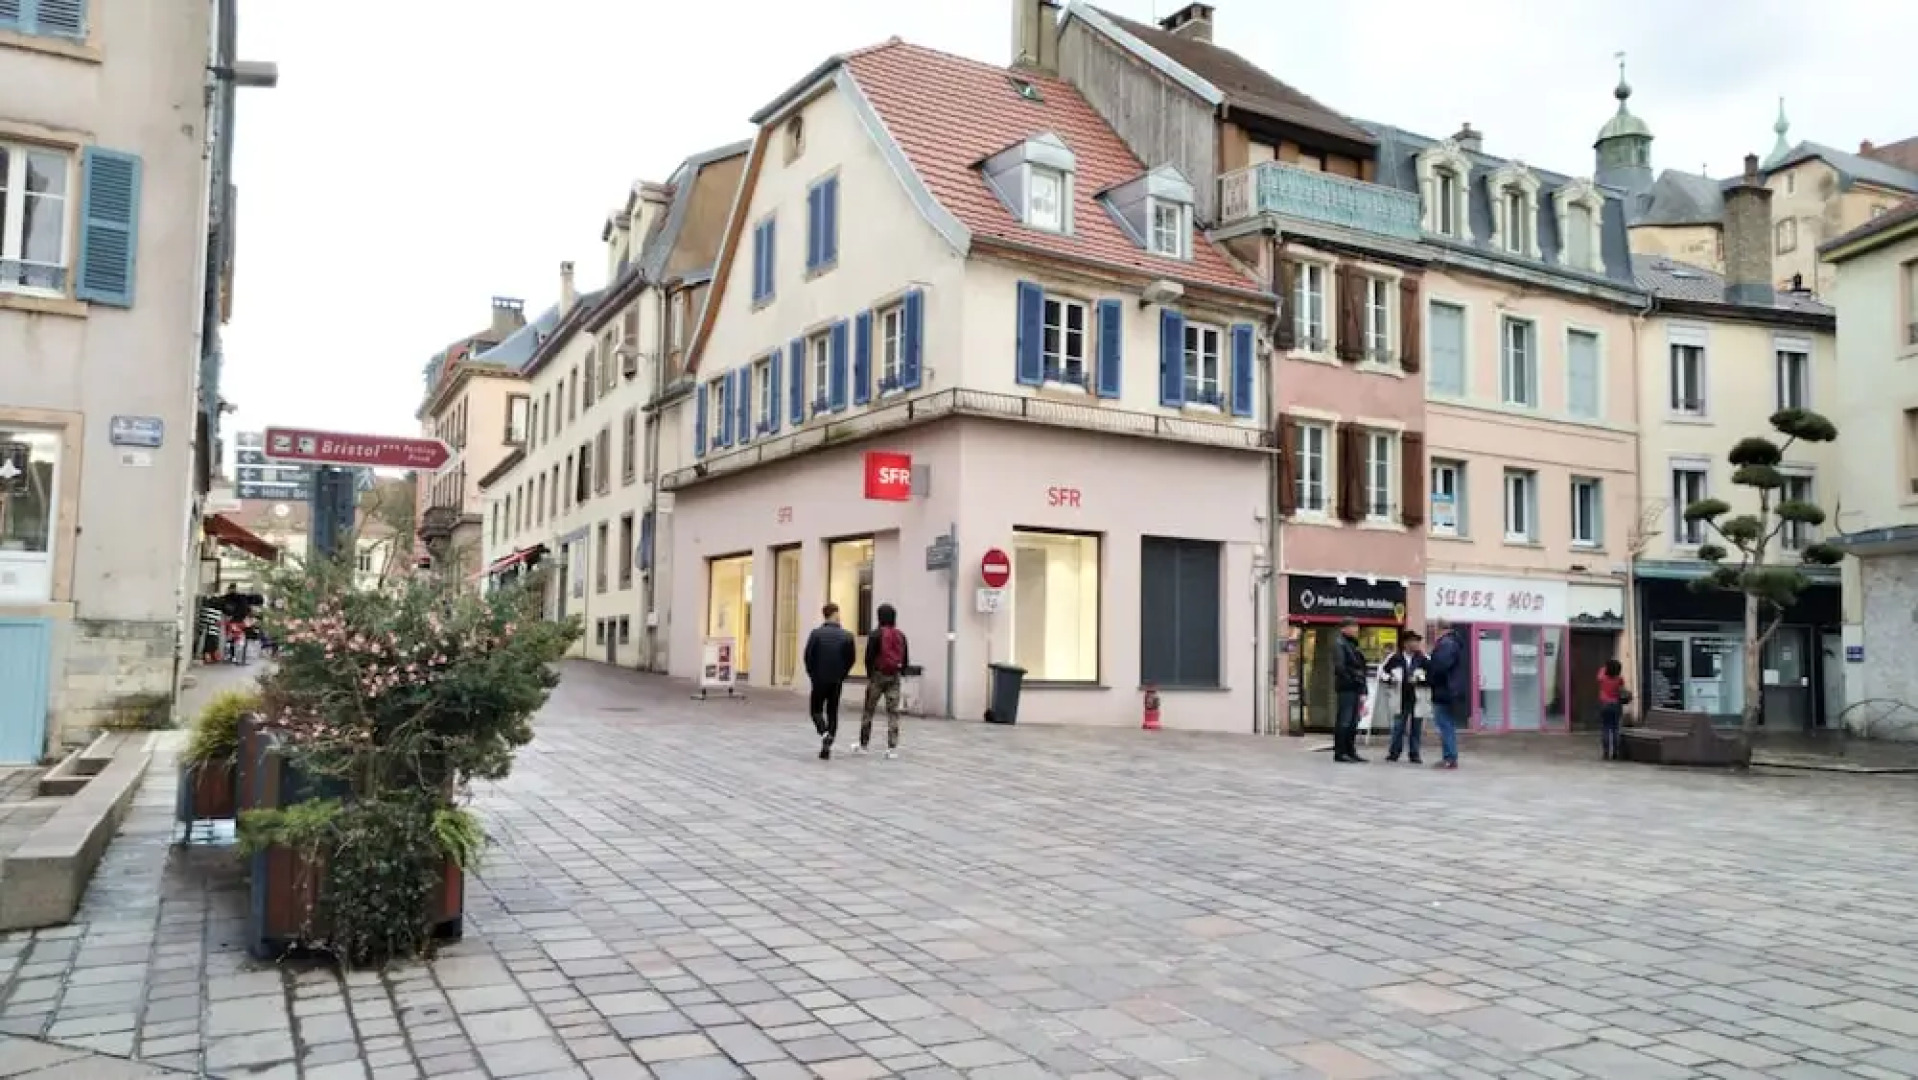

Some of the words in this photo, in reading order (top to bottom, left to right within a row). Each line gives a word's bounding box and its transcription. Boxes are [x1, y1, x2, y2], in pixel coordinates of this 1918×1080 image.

[321, 440, 380, 457] Bristol
[879, 467, 911, 485] SFR
[1048, 486, 1081, 508] SFR
[1317, 595, 1338, 607] Point
[1435, 586, 1496, 611] SUPER
[1507, 591, 1545, 611] MOD
